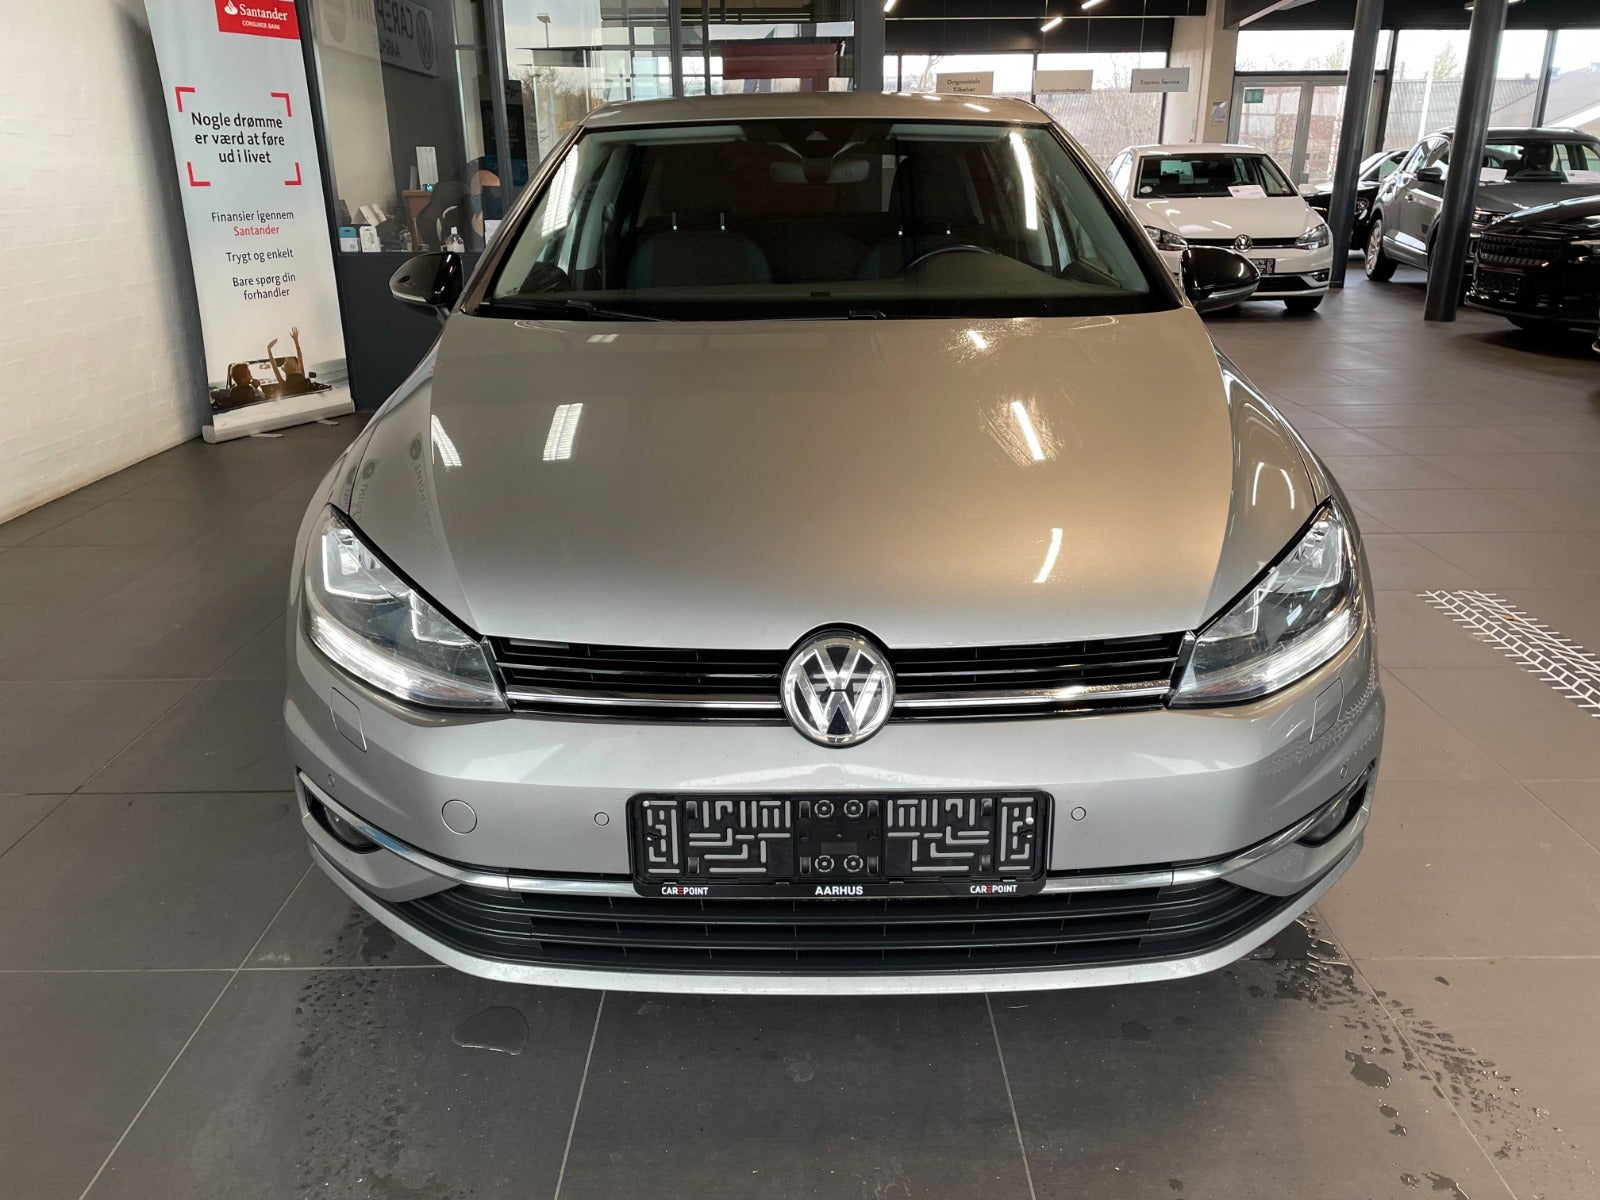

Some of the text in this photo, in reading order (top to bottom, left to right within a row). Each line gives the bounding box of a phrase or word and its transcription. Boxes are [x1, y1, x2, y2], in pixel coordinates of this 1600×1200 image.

[239, 3, 288, 21] Santander
[241, 20, 268, 29] CONSUMER
[191, 112, 283, 130] Nogle drømme
[195, 130, 285, 146] er værd at føre
[218, 148, 272, 163] ud i livet
[211, 210, 294, 223] Finansier igennem
[233, 224, 280, 237] Santander
[226, 248, 294, 265] Trygt og enkelt
[232, 272, 296, 287] Bare spørg din
[243, 286, 290, 301] forhandler
[815, 886, 864, 896] AARHUS
